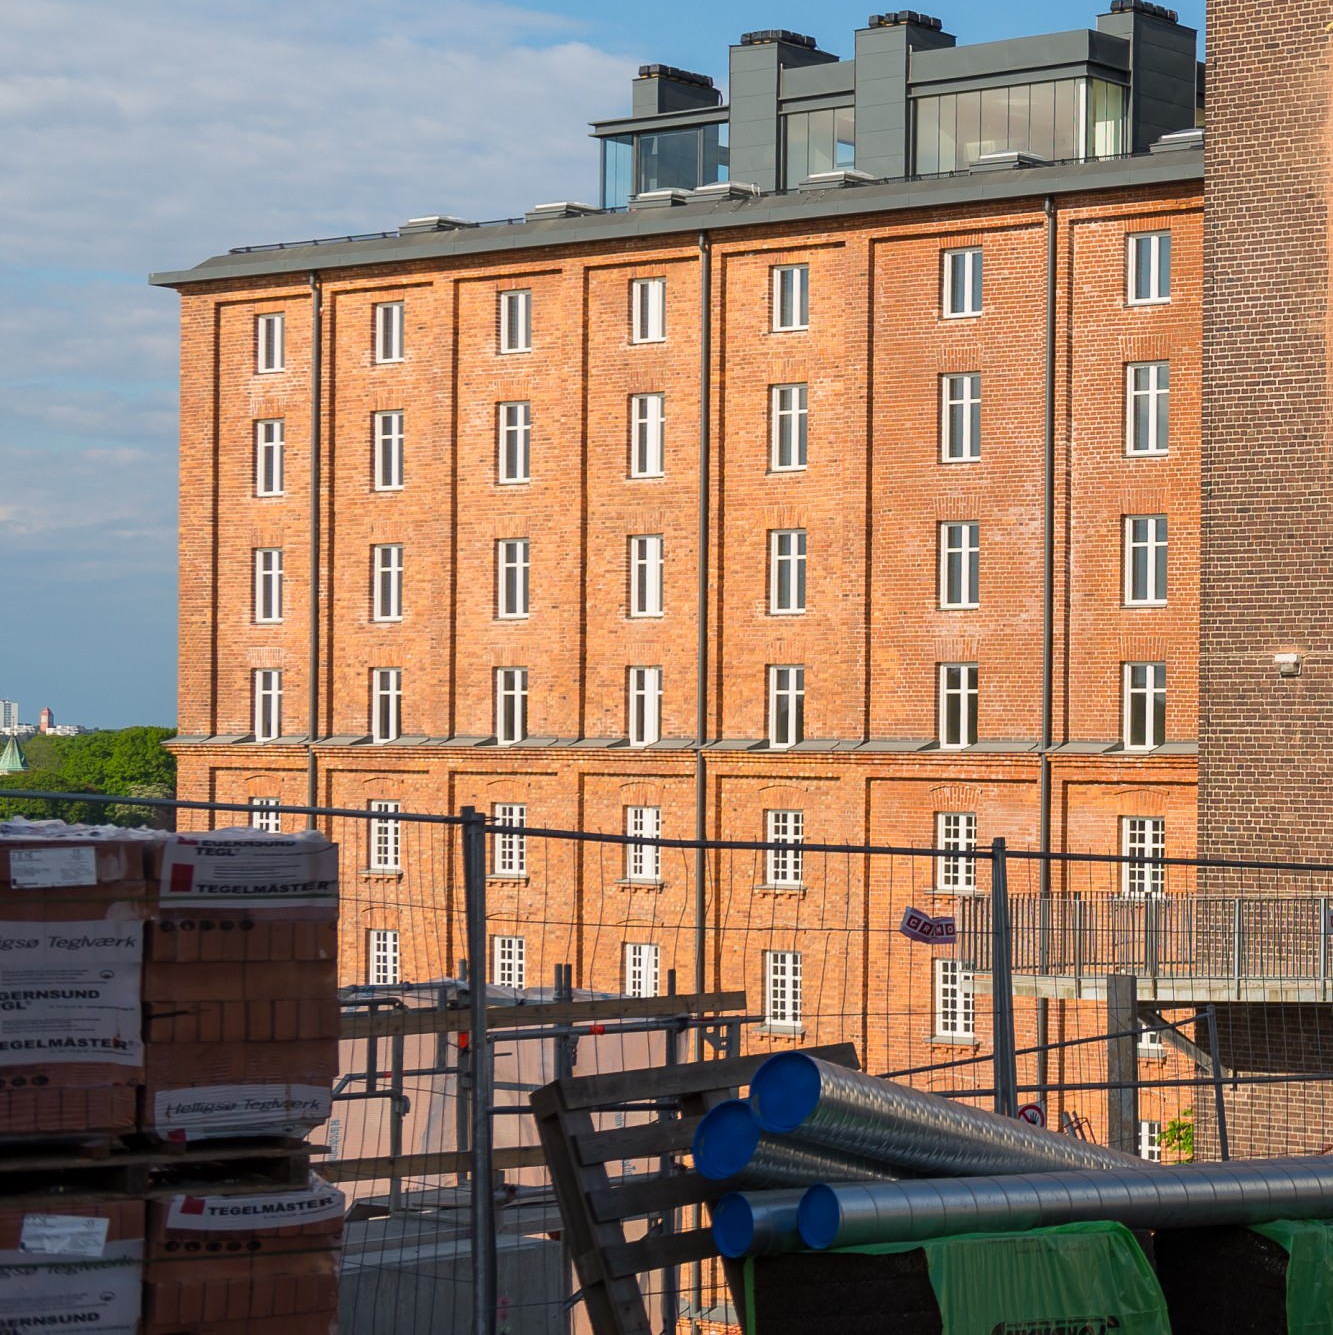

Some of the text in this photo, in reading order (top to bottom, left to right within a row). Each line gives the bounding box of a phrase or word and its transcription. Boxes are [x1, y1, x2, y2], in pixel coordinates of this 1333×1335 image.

[197, 880, 330, 894] TEGELMÄSTER
[48, 935, 136, 951] Teglværk
[208, 1196, 334, 1216] TEGELMÄSTER
